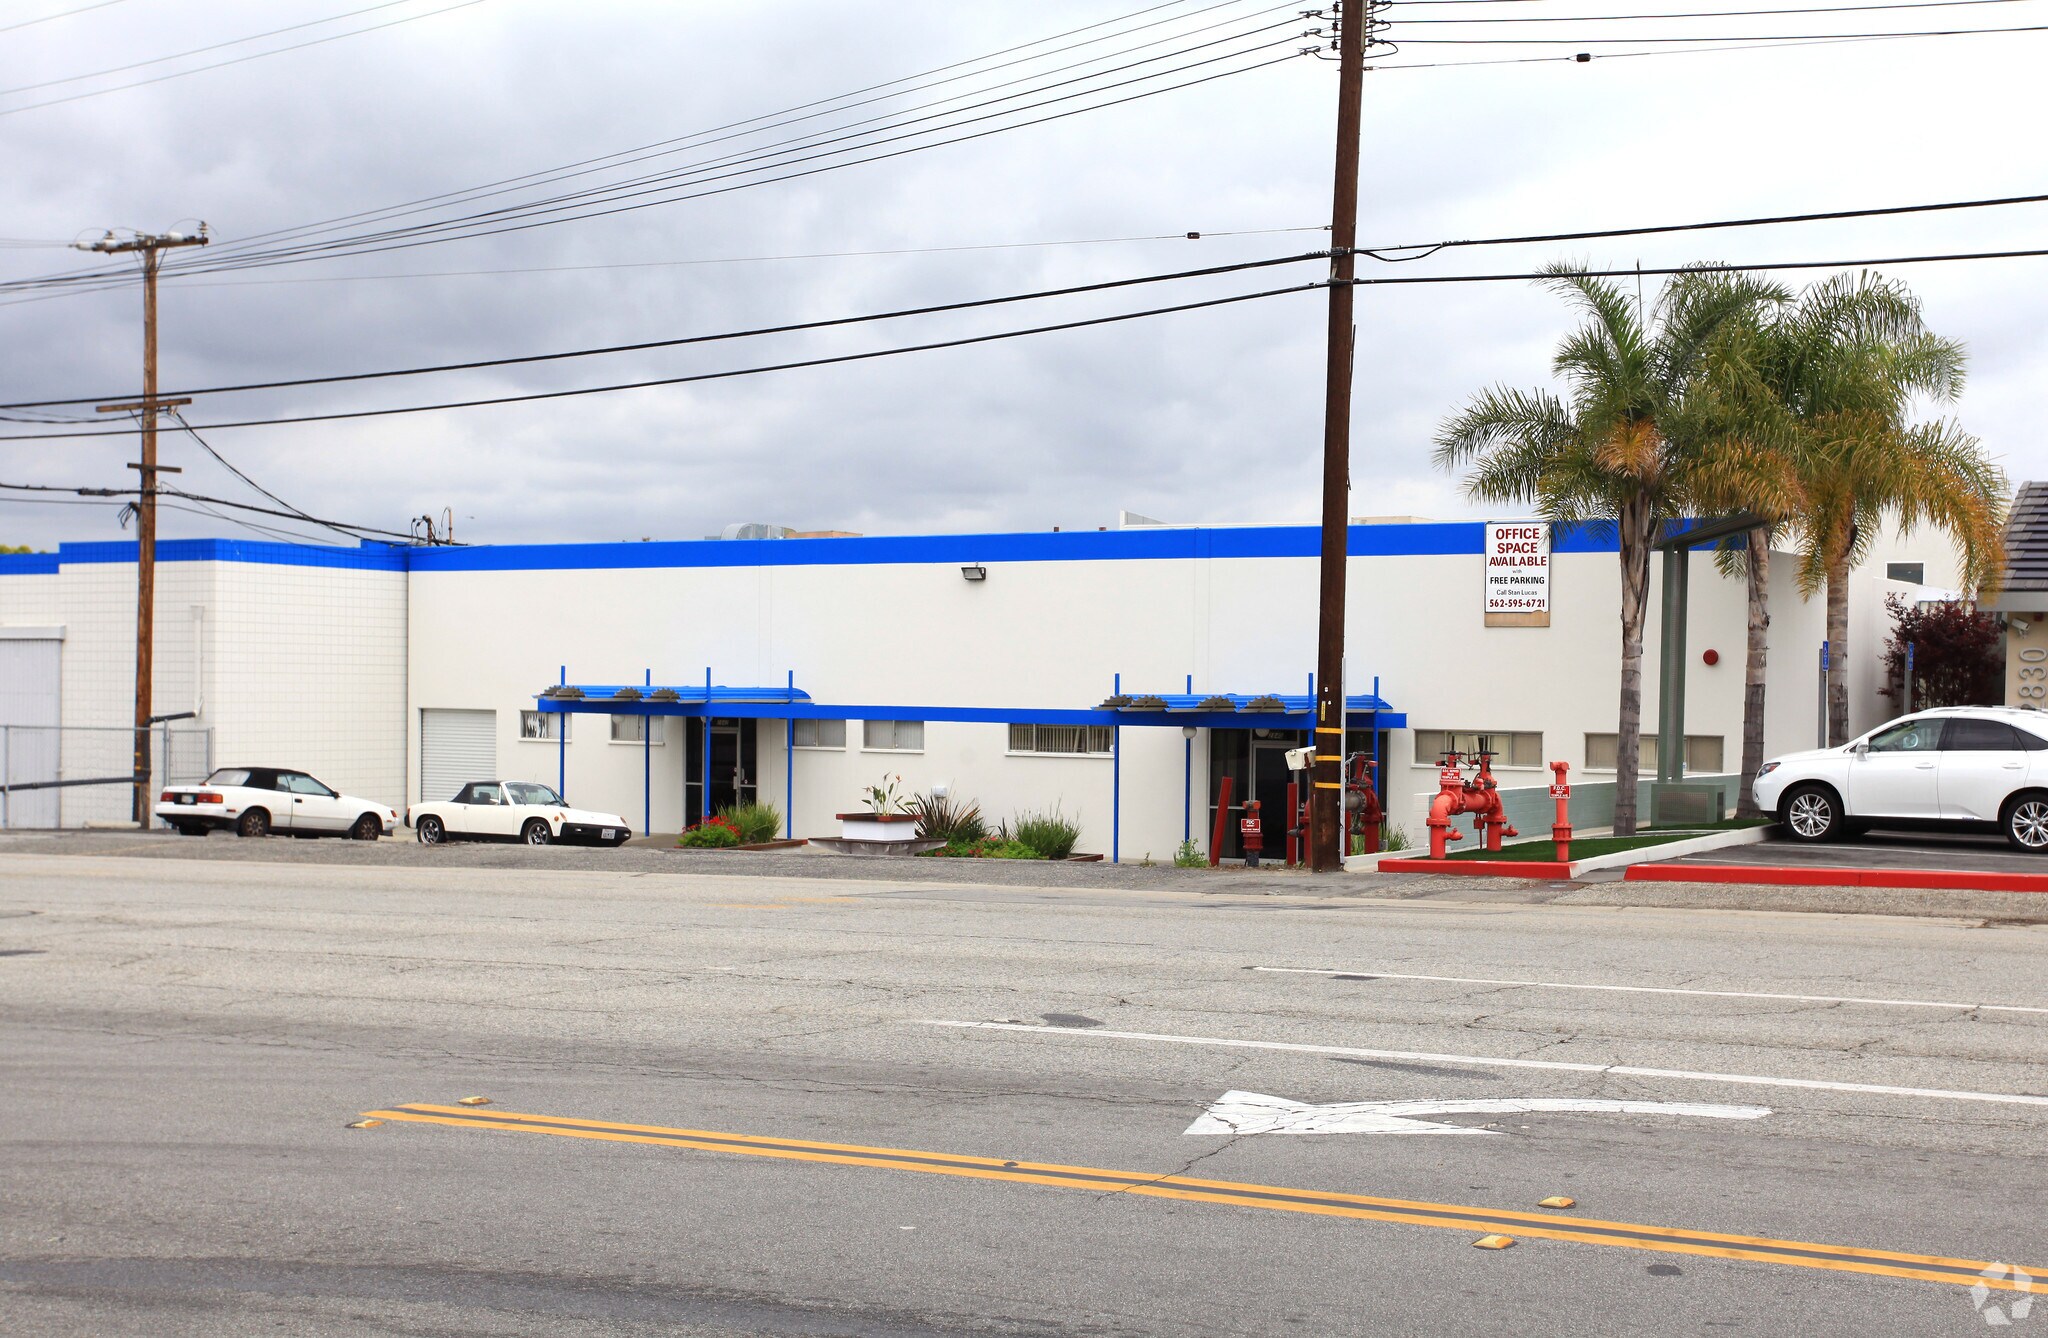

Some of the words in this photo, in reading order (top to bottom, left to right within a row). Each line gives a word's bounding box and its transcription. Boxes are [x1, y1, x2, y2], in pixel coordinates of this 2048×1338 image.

[1496, 528, 1540, 539] OFFICE
[1497, 542, 1538, 554] SPACE
[1489, 556, 1547, 567] AVAILABLE
[1510, 576, 1545, 585] PARKING
[1489, 599, 1545, 607] 562-595-6721
